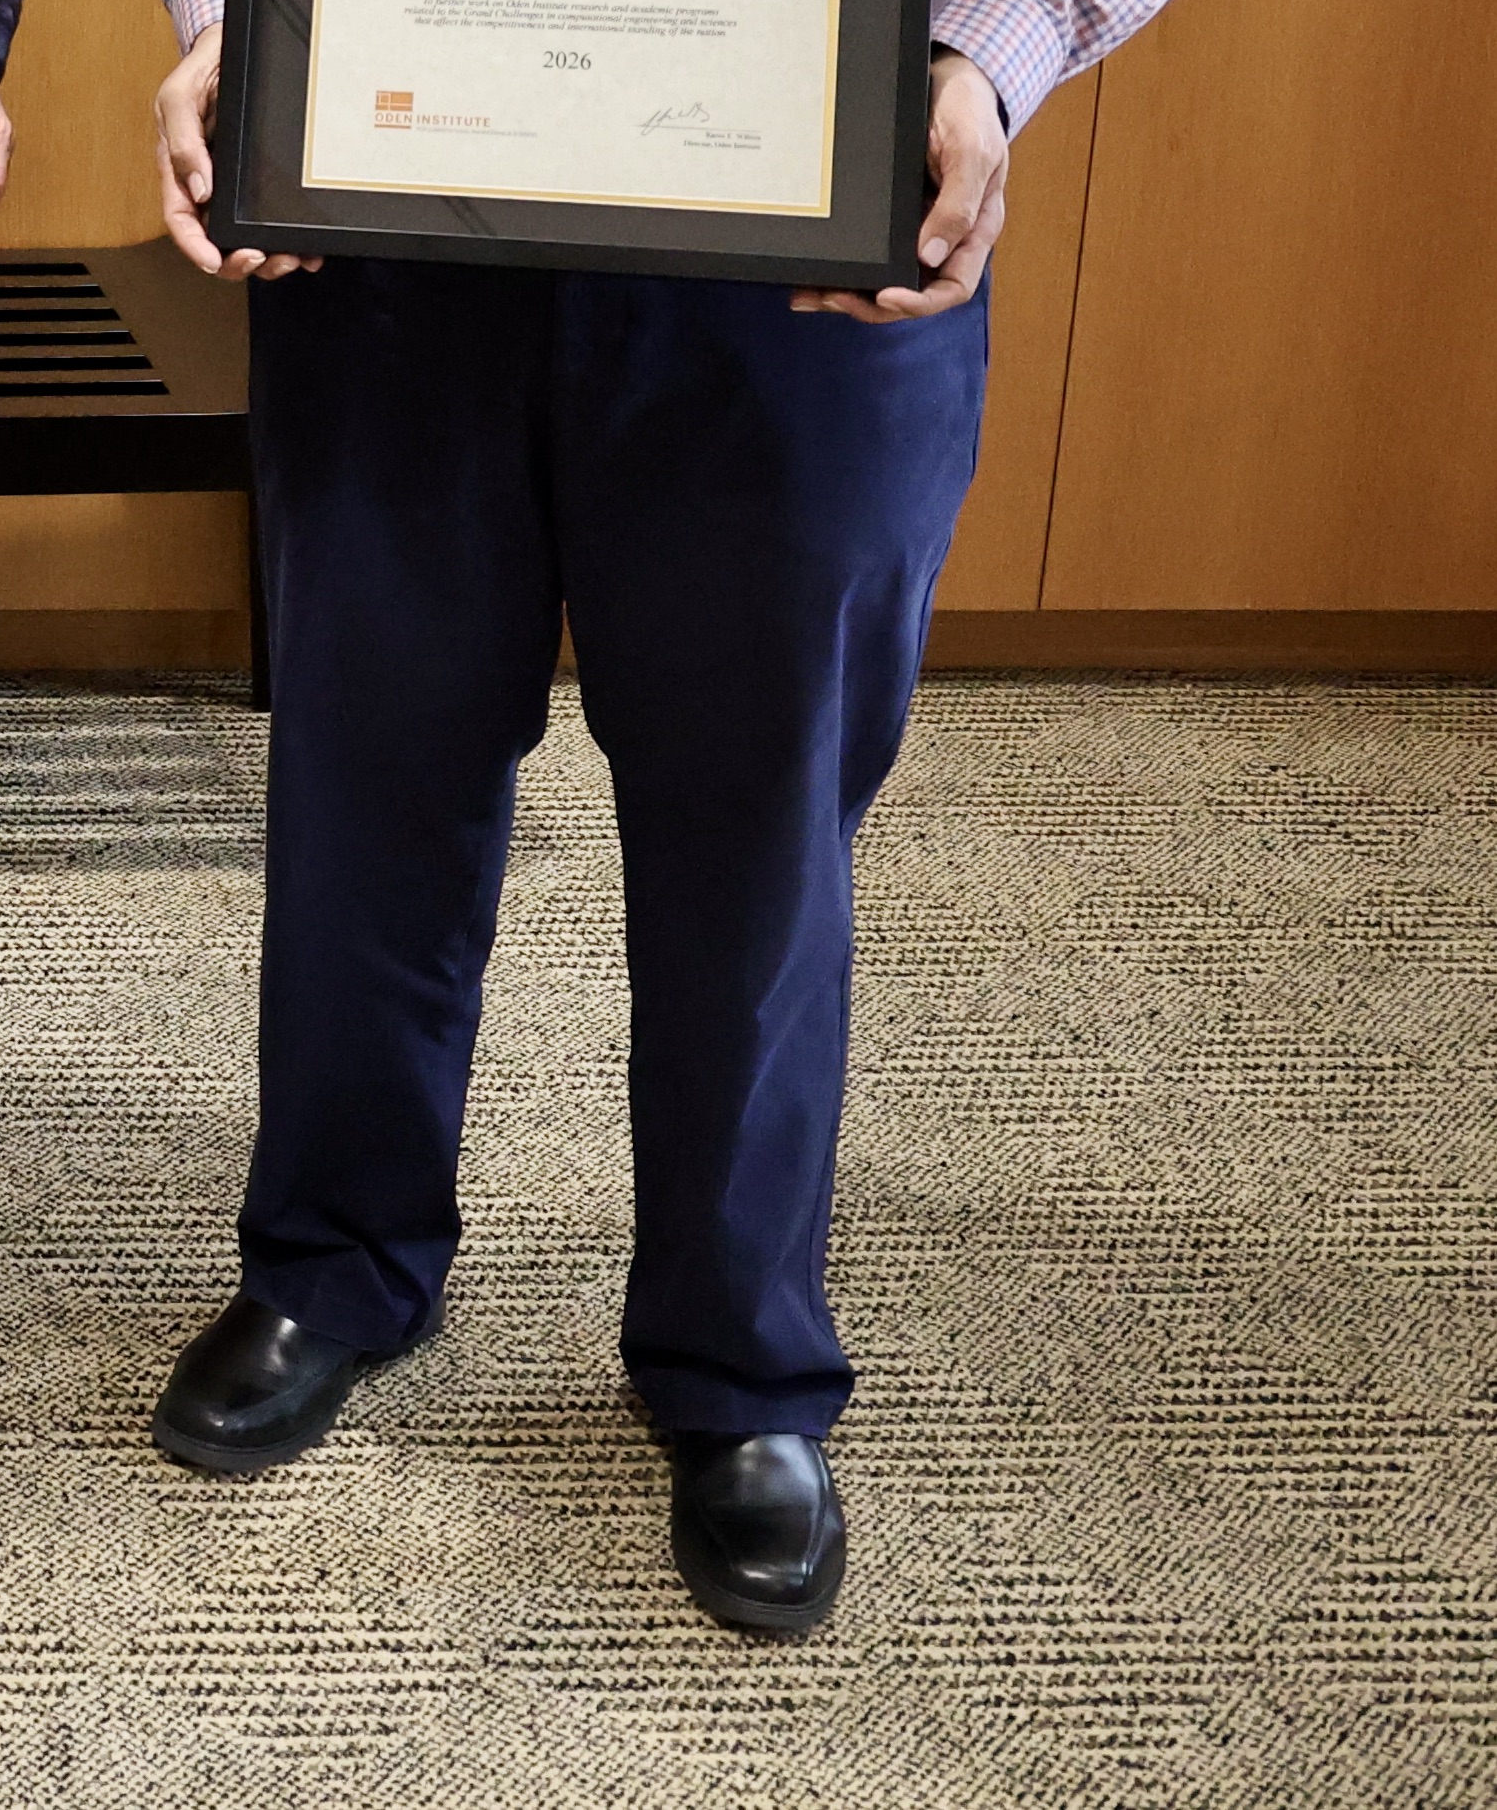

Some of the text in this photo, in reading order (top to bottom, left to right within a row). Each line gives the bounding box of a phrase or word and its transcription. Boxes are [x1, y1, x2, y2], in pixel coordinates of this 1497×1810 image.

[542, 51, 591, 70] 2026
[374, 112, 490, 128] ODEN INSTITUTE
